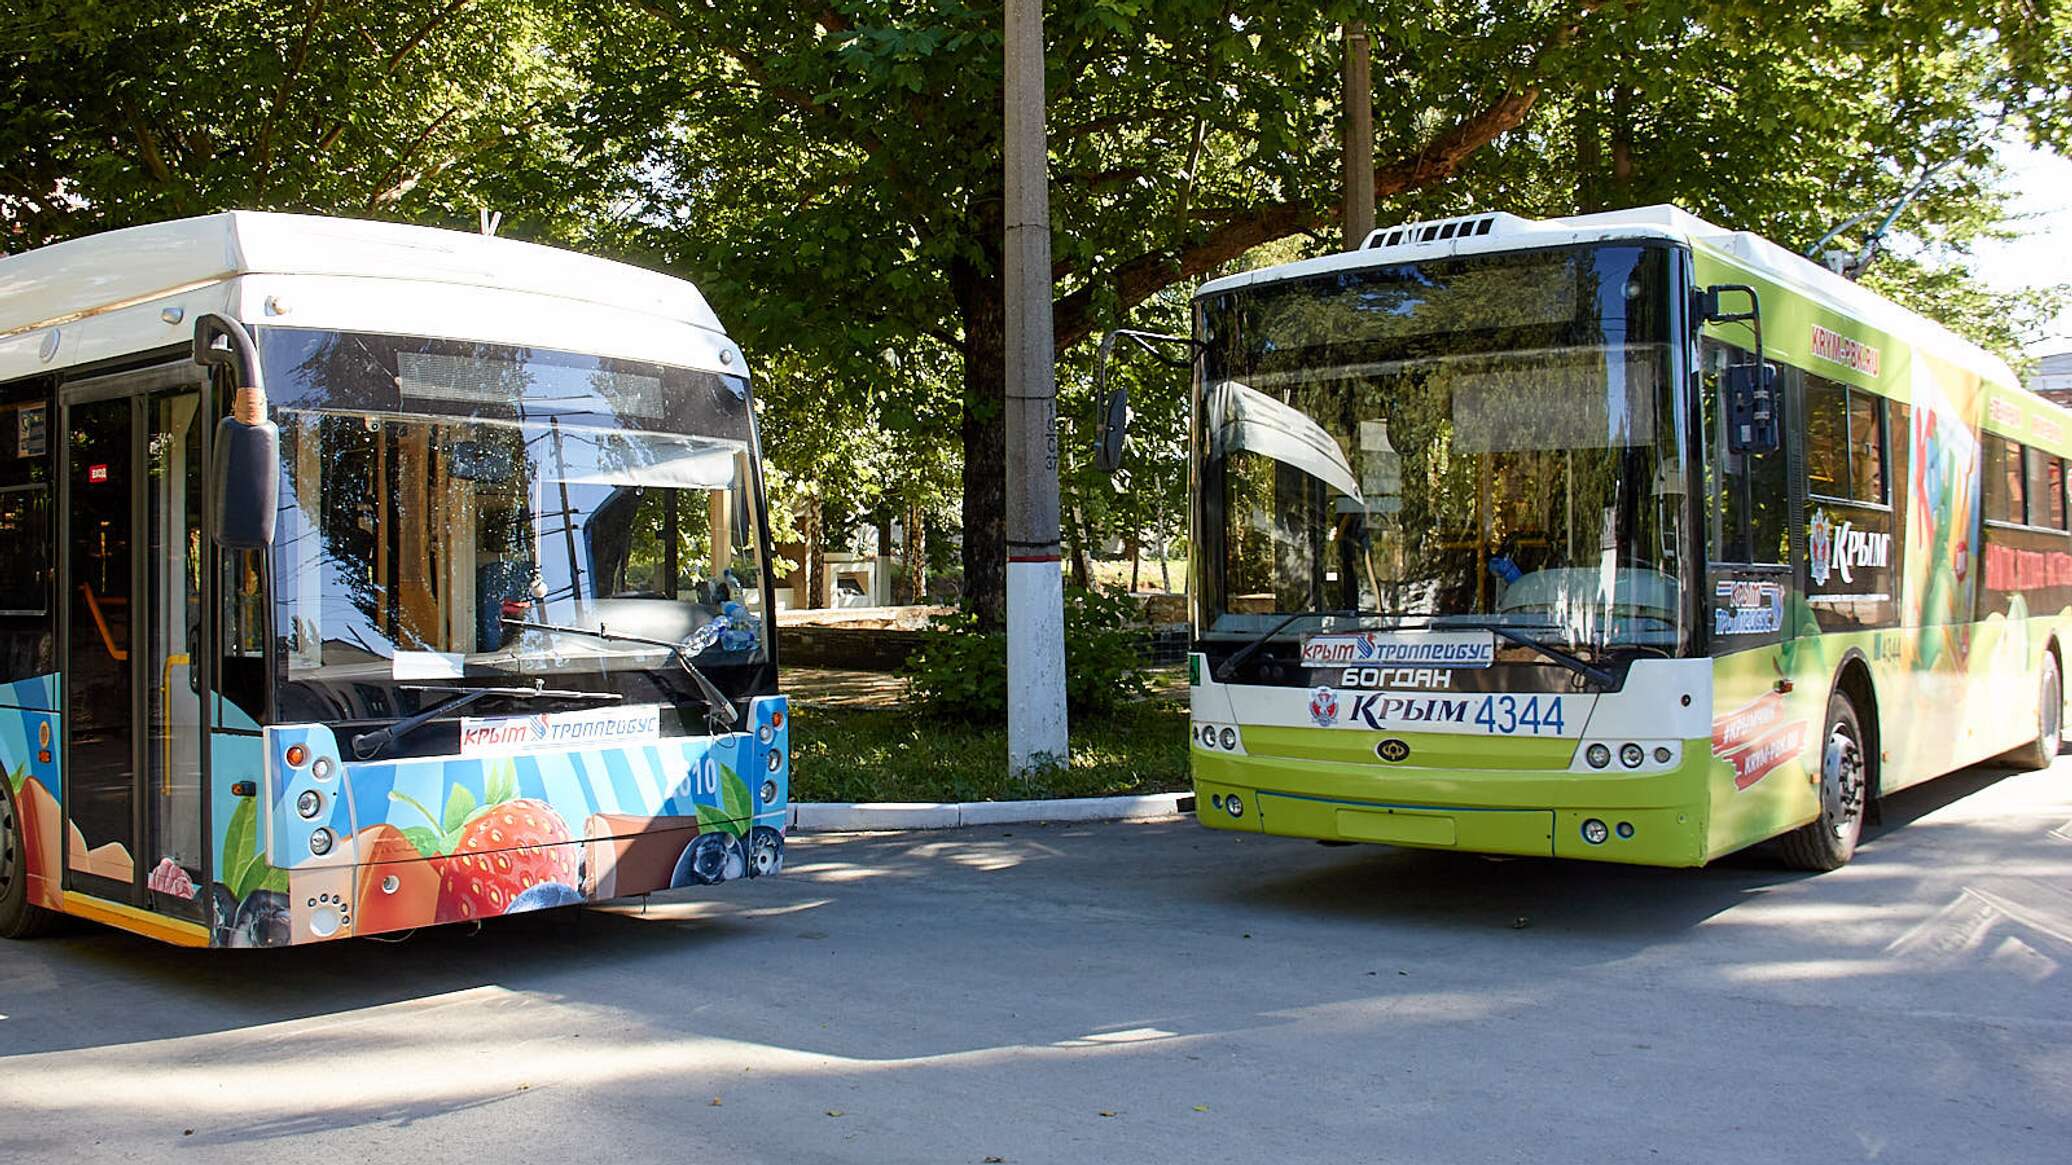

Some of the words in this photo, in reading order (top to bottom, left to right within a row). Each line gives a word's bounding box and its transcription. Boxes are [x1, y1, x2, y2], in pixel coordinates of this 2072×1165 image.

[1303, 644, 1354, 659] КРЫМ
[1341, 668, 1452, 688] БОГДАН
[1475, 695, 1564, 735] 4344
[464, 726, 526, 745] КРЫМ
